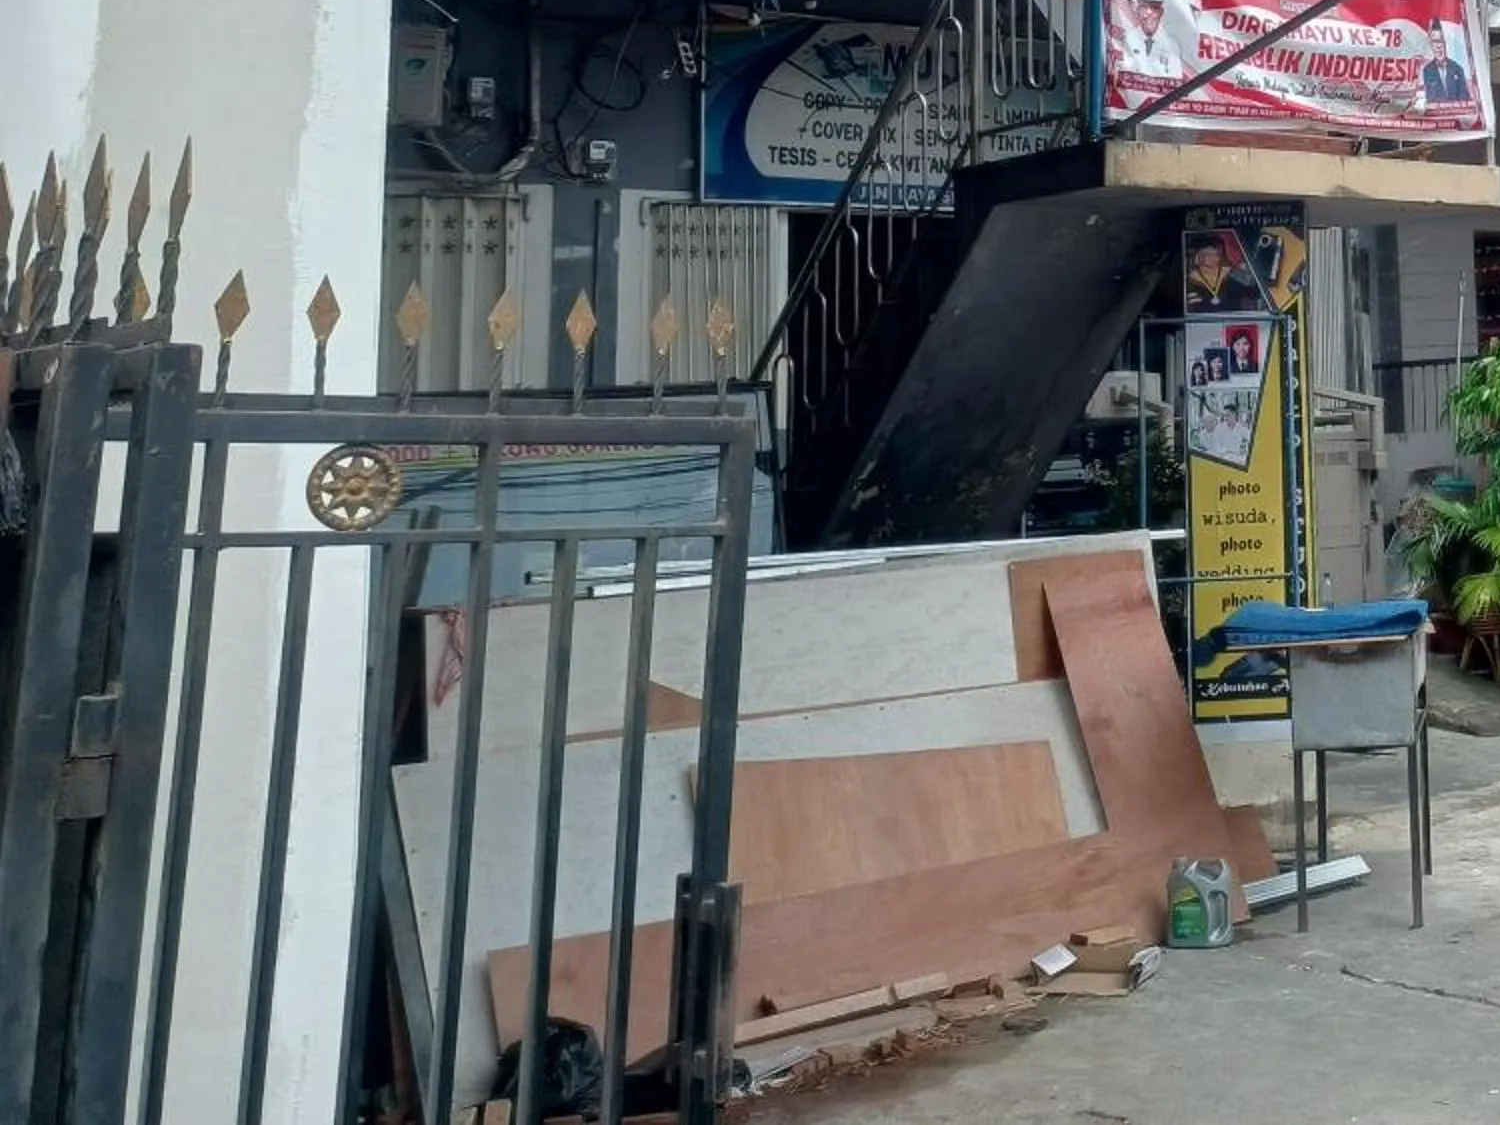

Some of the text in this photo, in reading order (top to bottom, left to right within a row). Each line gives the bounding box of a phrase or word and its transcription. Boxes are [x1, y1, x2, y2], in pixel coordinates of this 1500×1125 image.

[1222, 10, 1343, 44] DIRGHAYU
[1198, 32, 1305, 75] REPBLIK
[811, 120, 864, 142] COVER
[768, 145, 817, 167] TESIS
[1219, 480, 1262, 501] photo
[1220, 536, 1263, 557] photo
